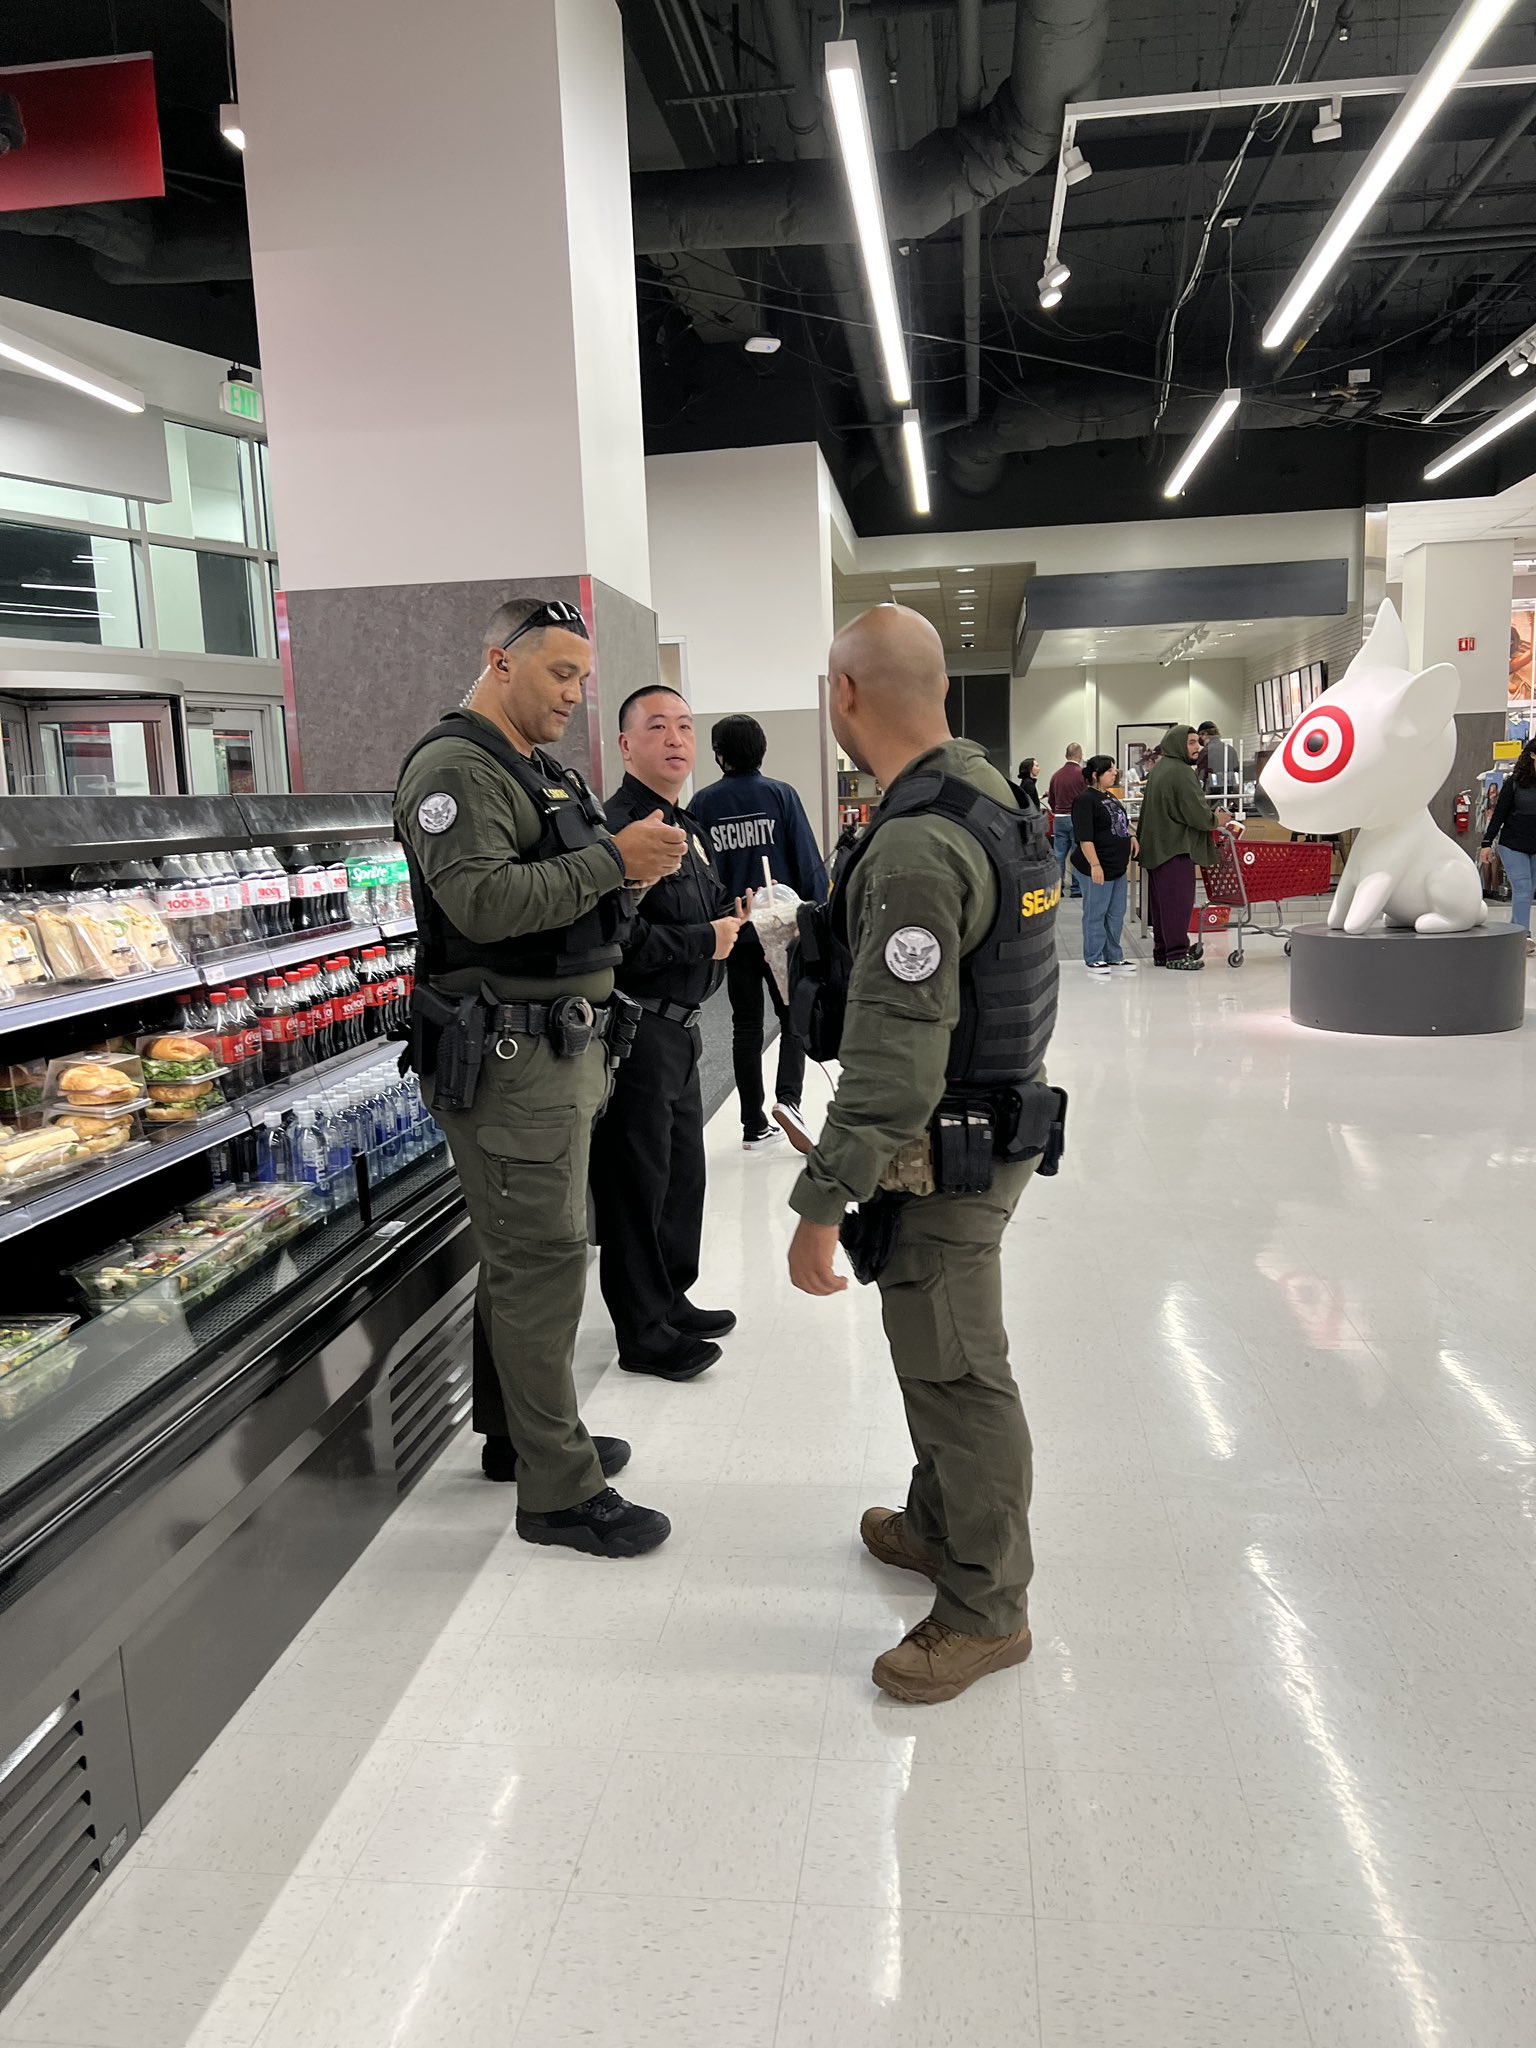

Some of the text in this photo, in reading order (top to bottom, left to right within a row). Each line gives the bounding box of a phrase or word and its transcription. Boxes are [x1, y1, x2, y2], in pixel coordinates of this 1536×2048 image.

[231, 384, 257, 417] EXIT
[710, 818, 776, 853] SECURITY
[351, 866, 389, 884] Sprite
[311, 1146, 331, 1192] smart
